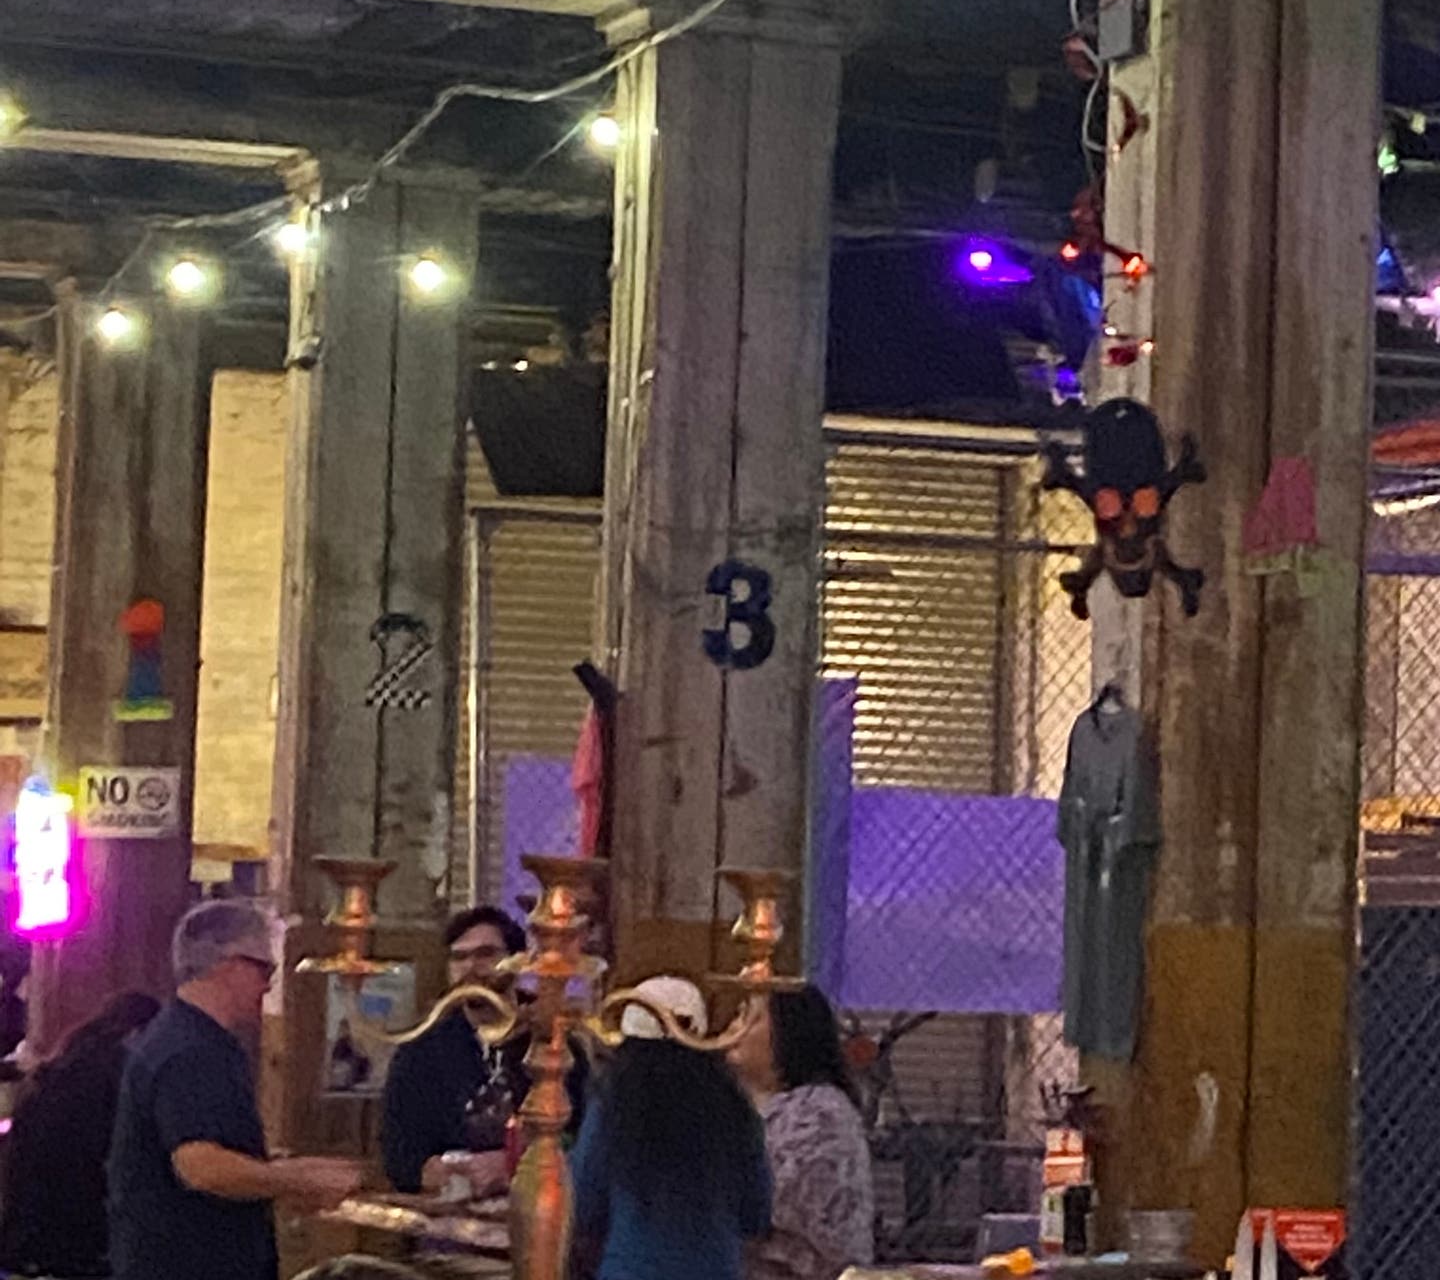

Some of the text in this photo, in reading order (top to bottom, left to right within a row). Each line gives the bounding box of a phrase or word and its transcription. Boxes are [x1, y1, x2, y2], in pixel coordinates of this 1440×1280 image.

[365, 613, 434, 709] 2
[702, 559, 776, 669] 3
[86, 775, 130, 806] NO
